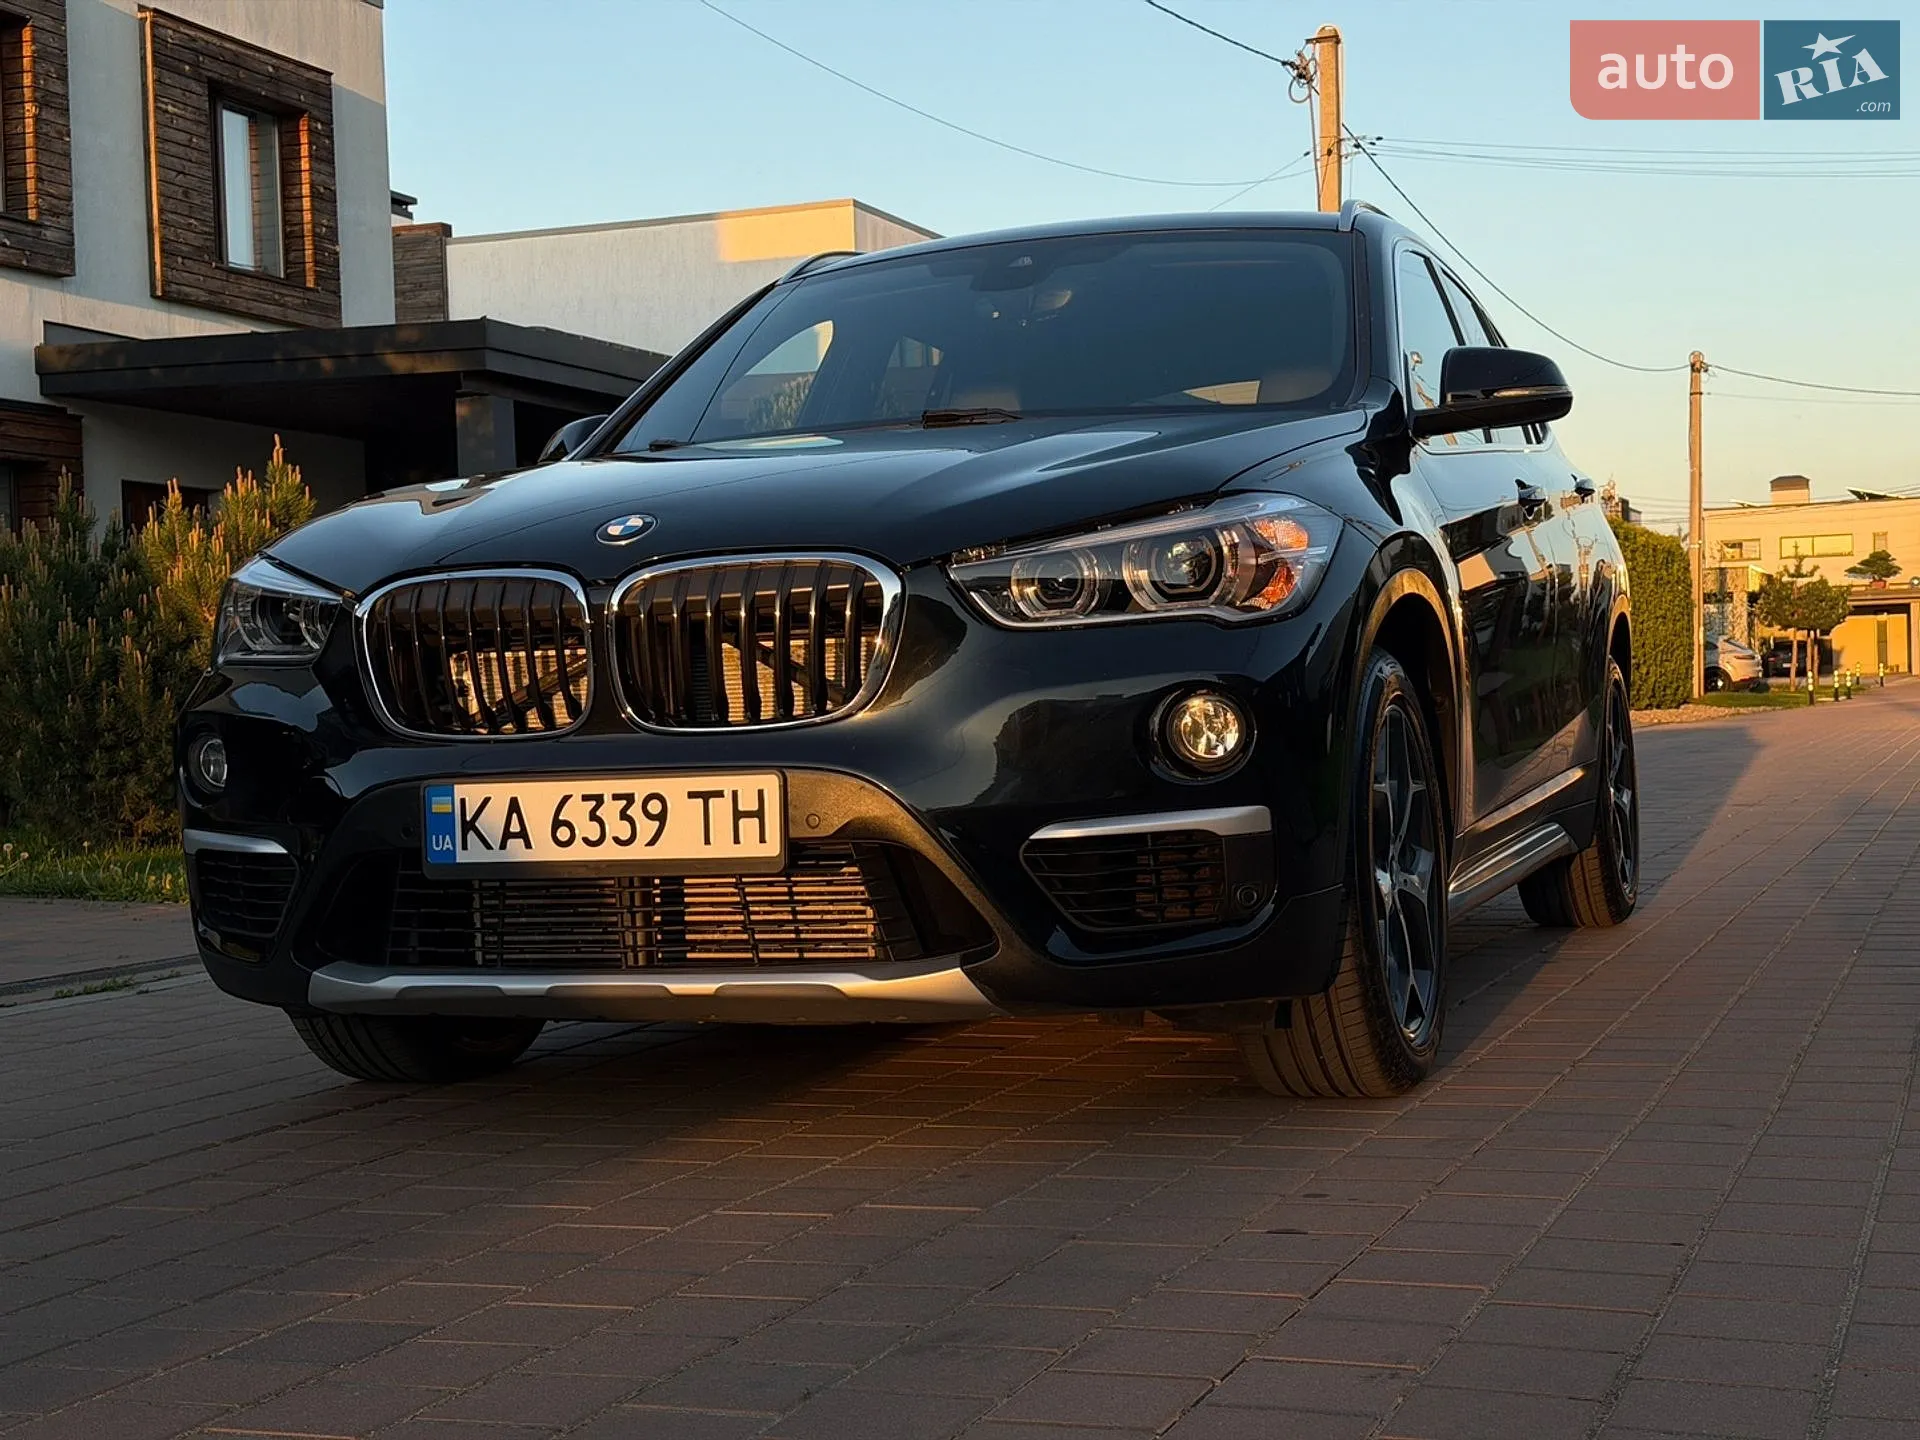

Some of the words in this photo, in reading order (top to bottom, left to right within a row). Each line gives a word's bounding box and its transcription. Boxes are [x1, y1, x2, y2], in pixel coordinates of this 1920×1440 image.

[459, 796, 533, 851] KA
[550, 792, 669, 848] 6339
[687, 788, 767, 846] TH
[432, 834, 453, 851] UA
